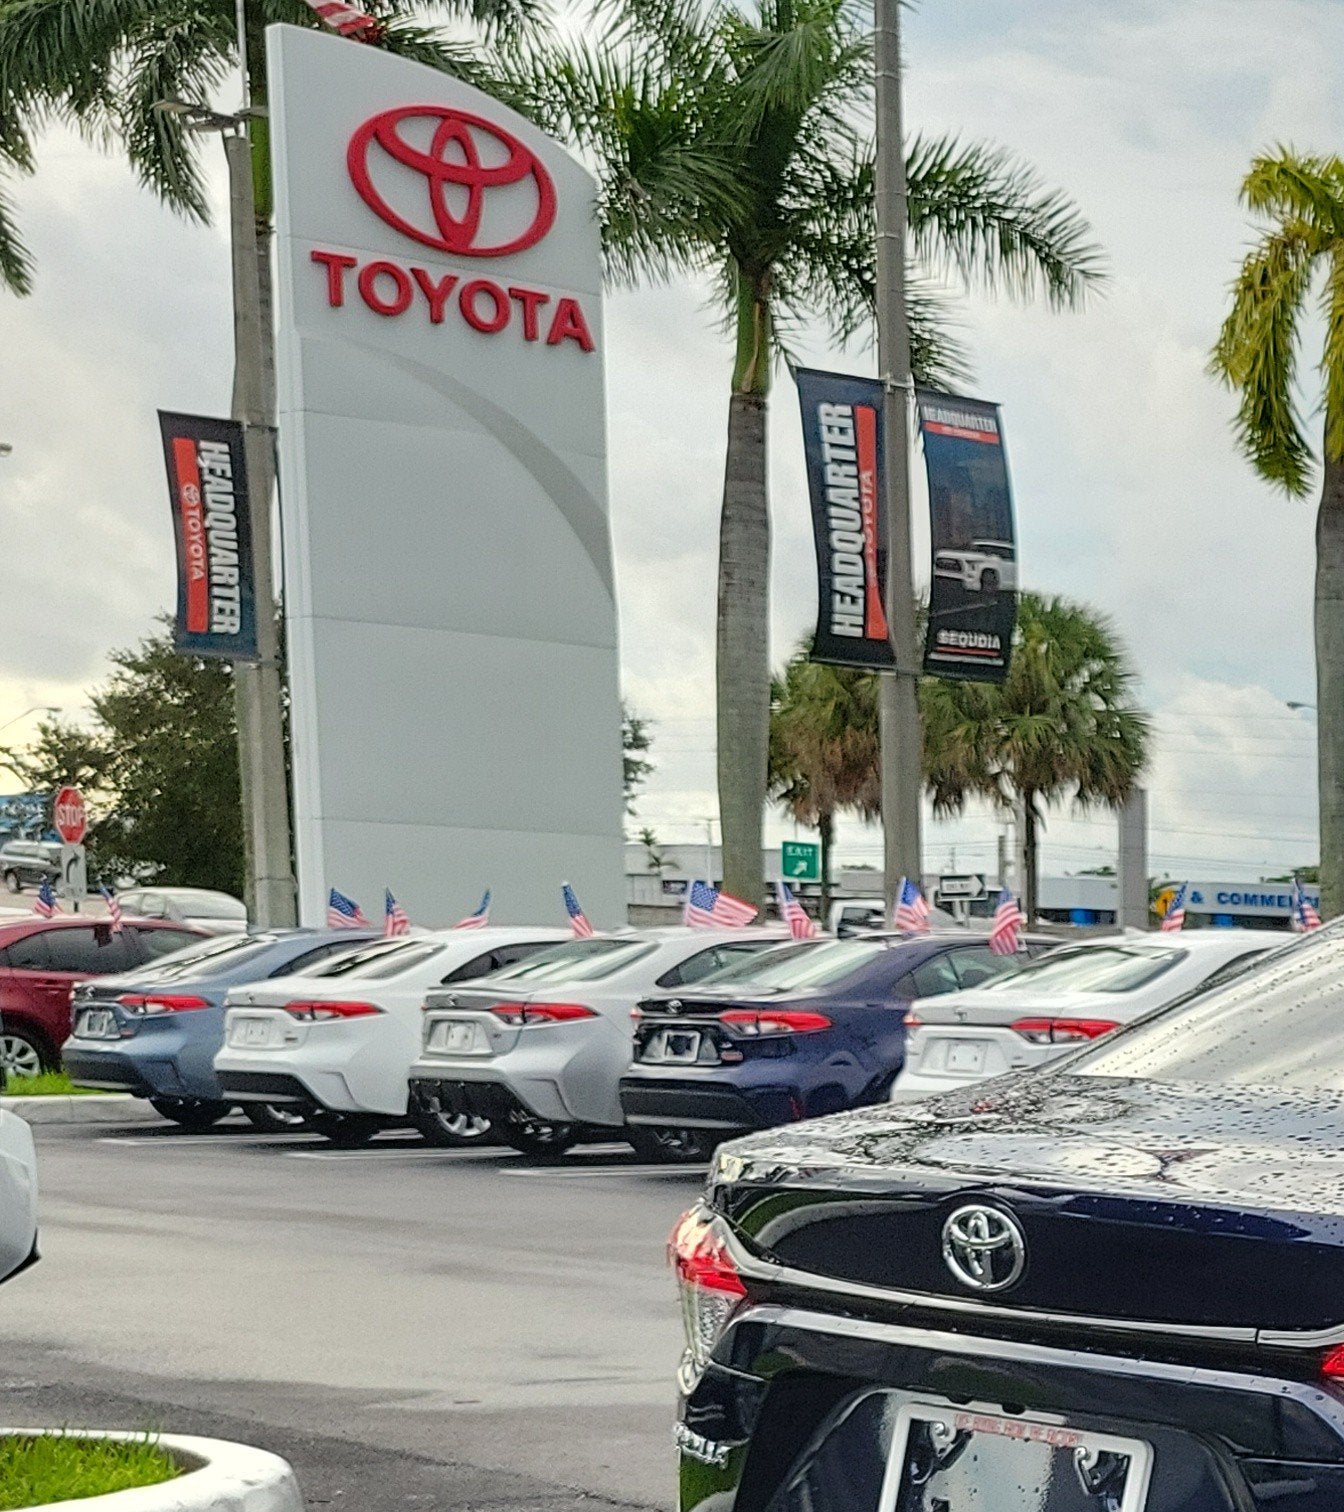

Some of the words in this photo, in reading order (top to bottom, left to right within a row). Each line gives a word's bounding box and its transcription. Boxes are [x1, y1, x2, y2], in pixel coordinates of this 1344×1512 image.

[310, 250, 595, 352] TOYOTA
[187, 508, 205, 580] TOYOTA
[198, 439, 242, 635] HEADQUARTER
[818, 402, 867, 638] HEADQUARTER
[937, 629, 1001, 650] SEQUOIA
[1190, 890, 1204, 904] &
